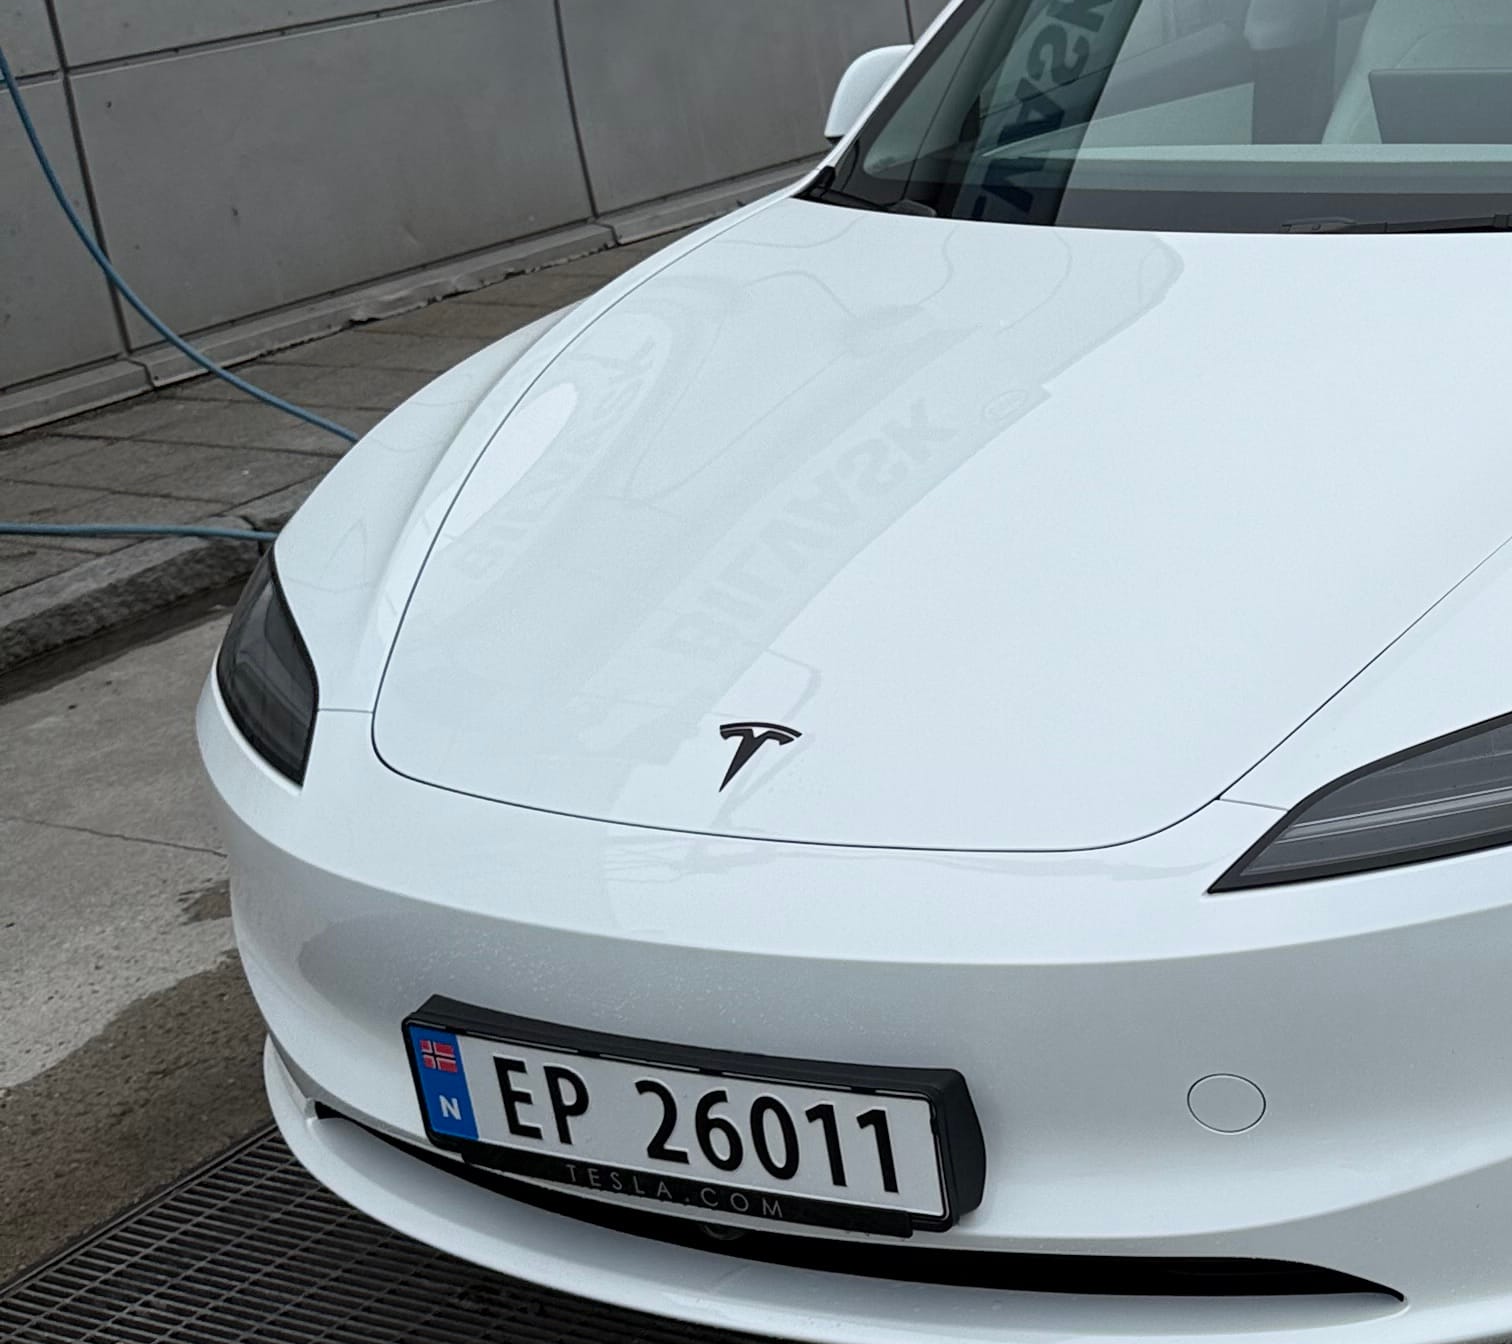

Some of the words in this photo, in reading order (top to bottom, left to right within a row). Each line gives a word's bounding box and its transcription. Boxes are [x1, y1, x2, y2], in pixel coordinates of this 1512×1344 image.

[439, 1095, 462, 1121] N
[493, 1054, 590, 1146] EP
[634, 1077, 901, 1195] 26011
[565, 1163, 785, 1219] TESLA.COM
